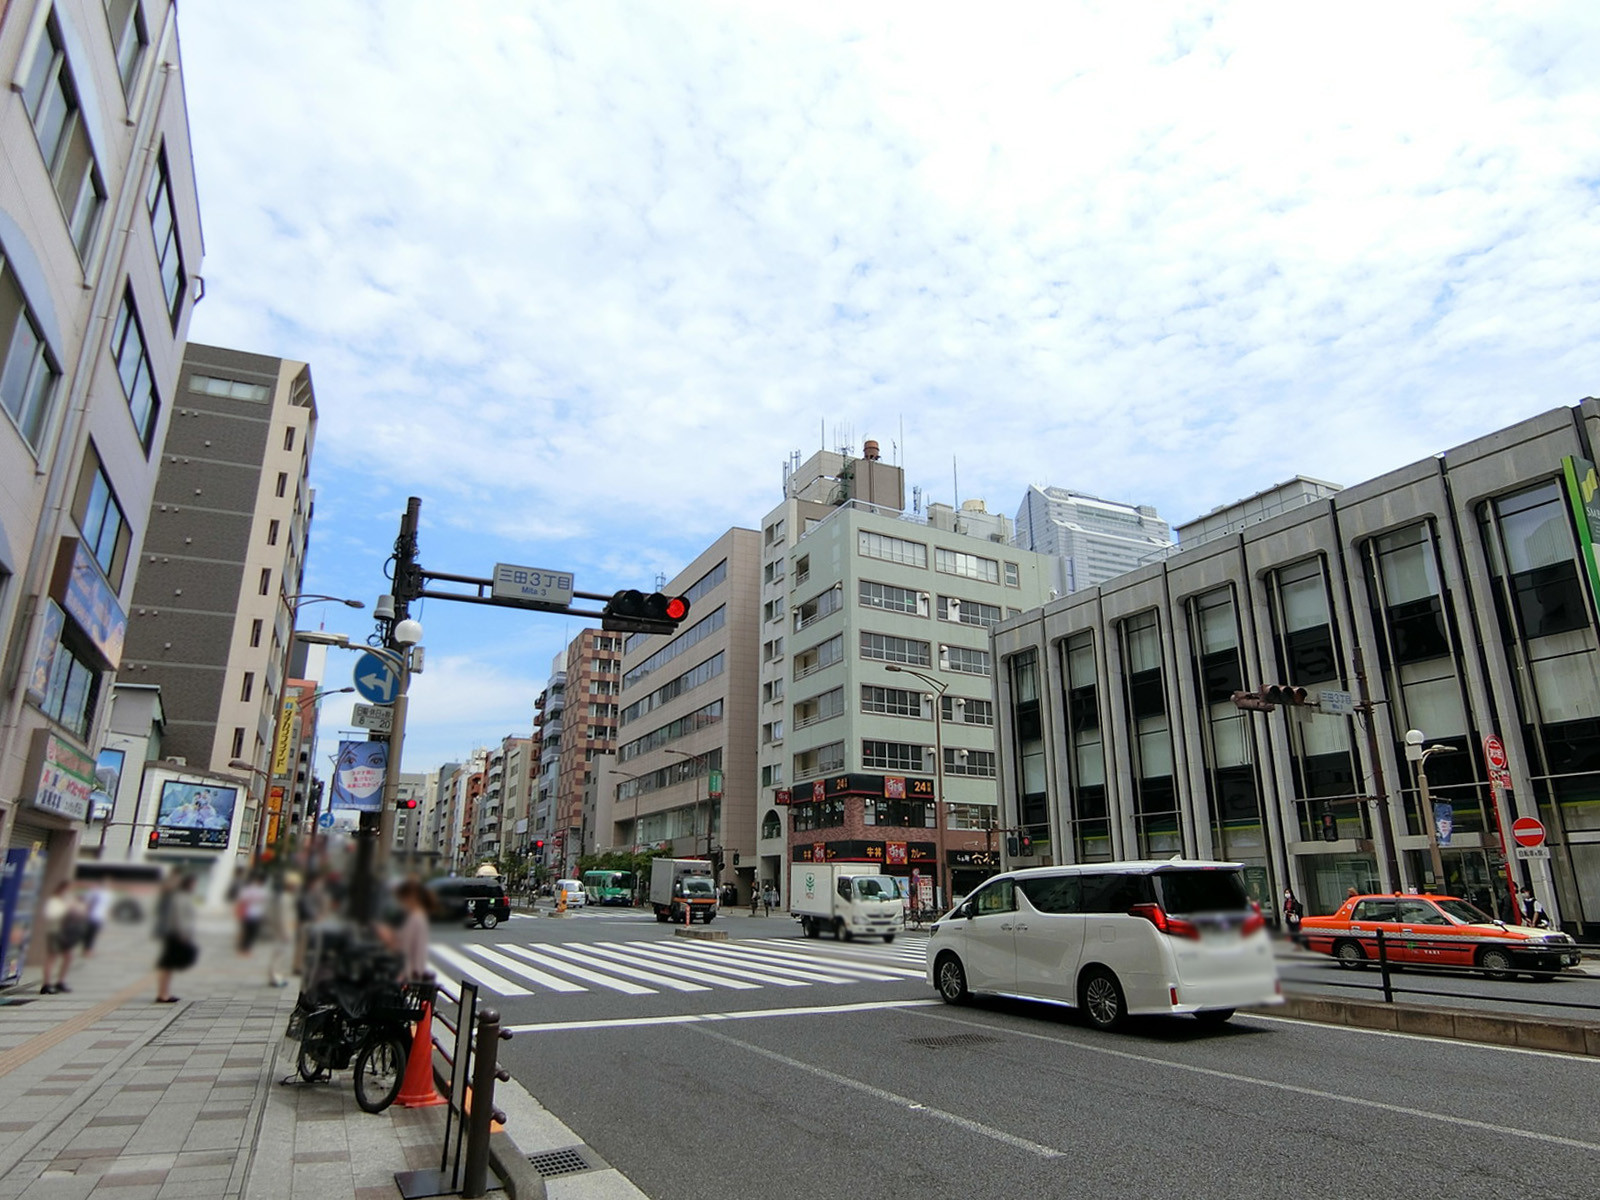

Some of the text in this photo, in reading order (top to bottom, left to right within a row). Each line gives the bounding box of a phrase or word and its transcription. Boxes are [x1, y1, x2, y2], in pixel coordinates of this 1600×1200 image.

[499, 568, 570, 590] 三田3丁目
[521, 586, 547, 597] Mita 3
[1321, 692, 1351, 705] 三田3丁目
[866, 846, 882, 858] 牛丼
[911, 847, 927, 859] カレー
